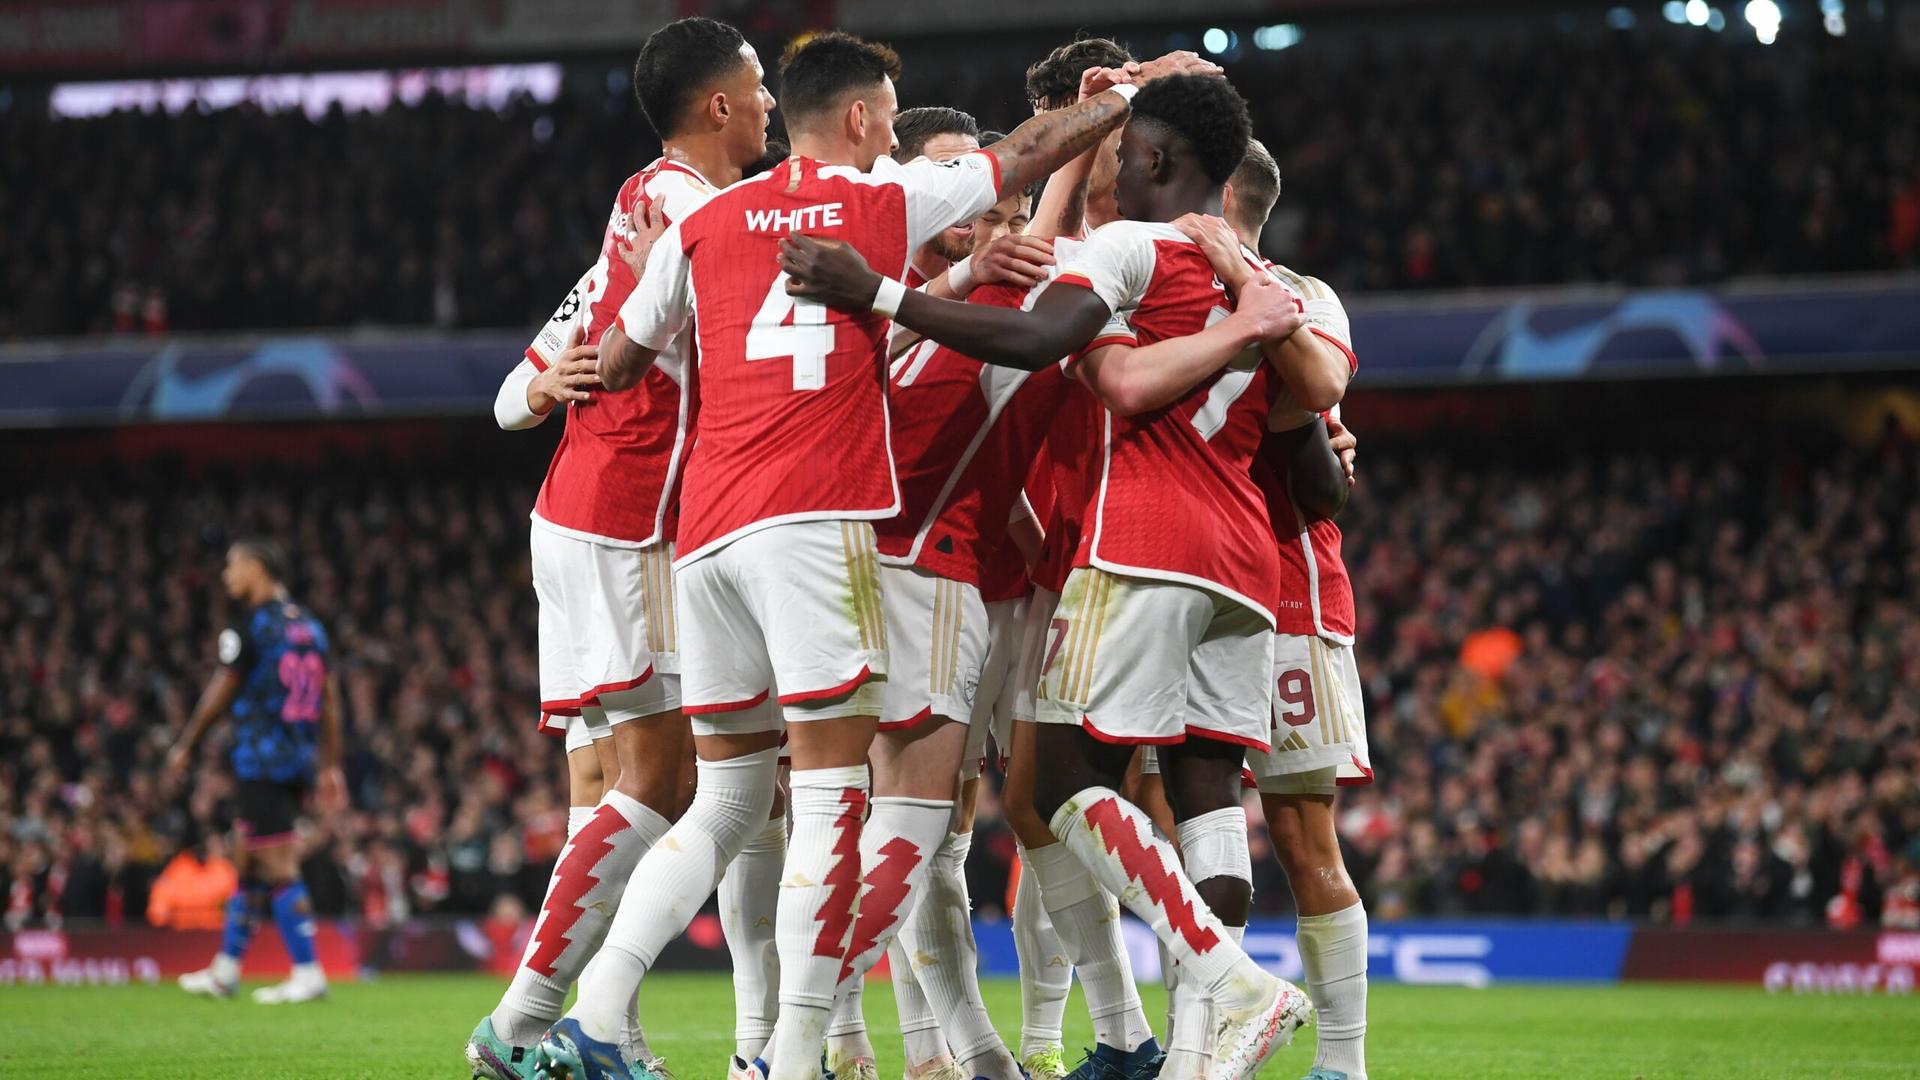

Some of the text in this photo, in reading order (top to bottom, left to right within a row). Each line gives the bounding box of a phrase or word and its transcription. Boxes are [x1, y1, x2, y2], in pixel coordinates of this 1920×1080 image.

[745, 202, 843, 232] WHITE
[746, 270, 835, 391] 4
[1041, 618, 1069, 676] 7
[1271, 668, 1316, 730] 9
